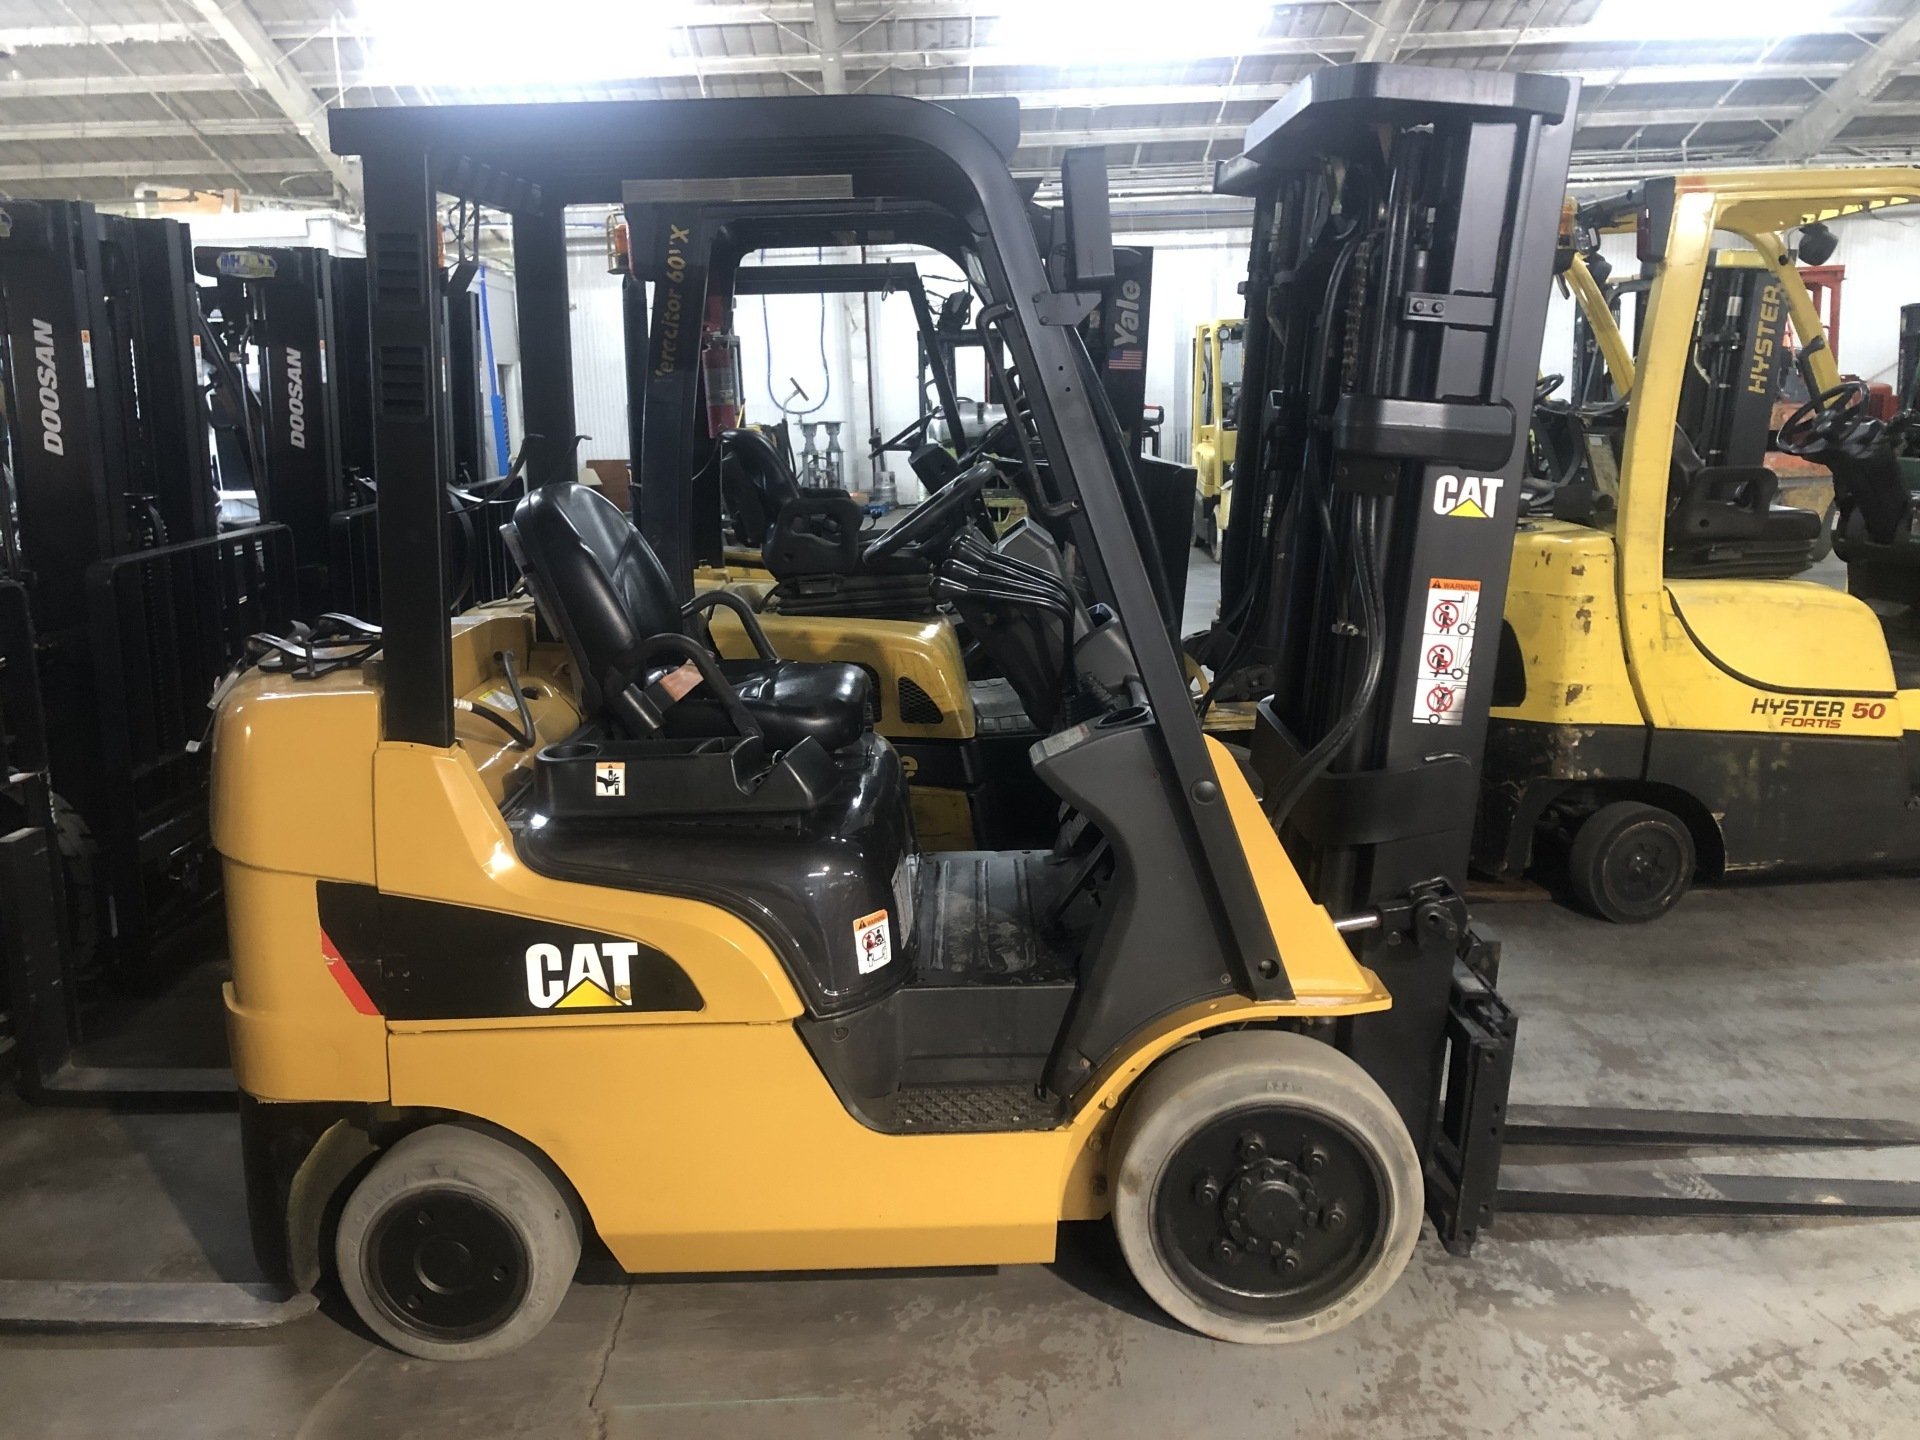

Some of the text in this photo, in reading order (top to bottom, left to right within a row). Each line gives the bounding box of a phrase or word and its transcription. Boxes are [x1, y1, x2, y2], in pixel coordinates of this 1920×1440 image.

[1114, 280, 1141, 346] Yale
[1748, 284, 1780, 394] HYSTER
[32, 318, 64, 456] DOOSAN
[286, 346, 306, 449] DOOSAN
[1433, 474, 1504, 518] CAT
[1751, 697, 1886, 720] HYSTER 50
[1780, 717, 1842, 729] FORTIS
[525, 941, 639, 1009] CAT
